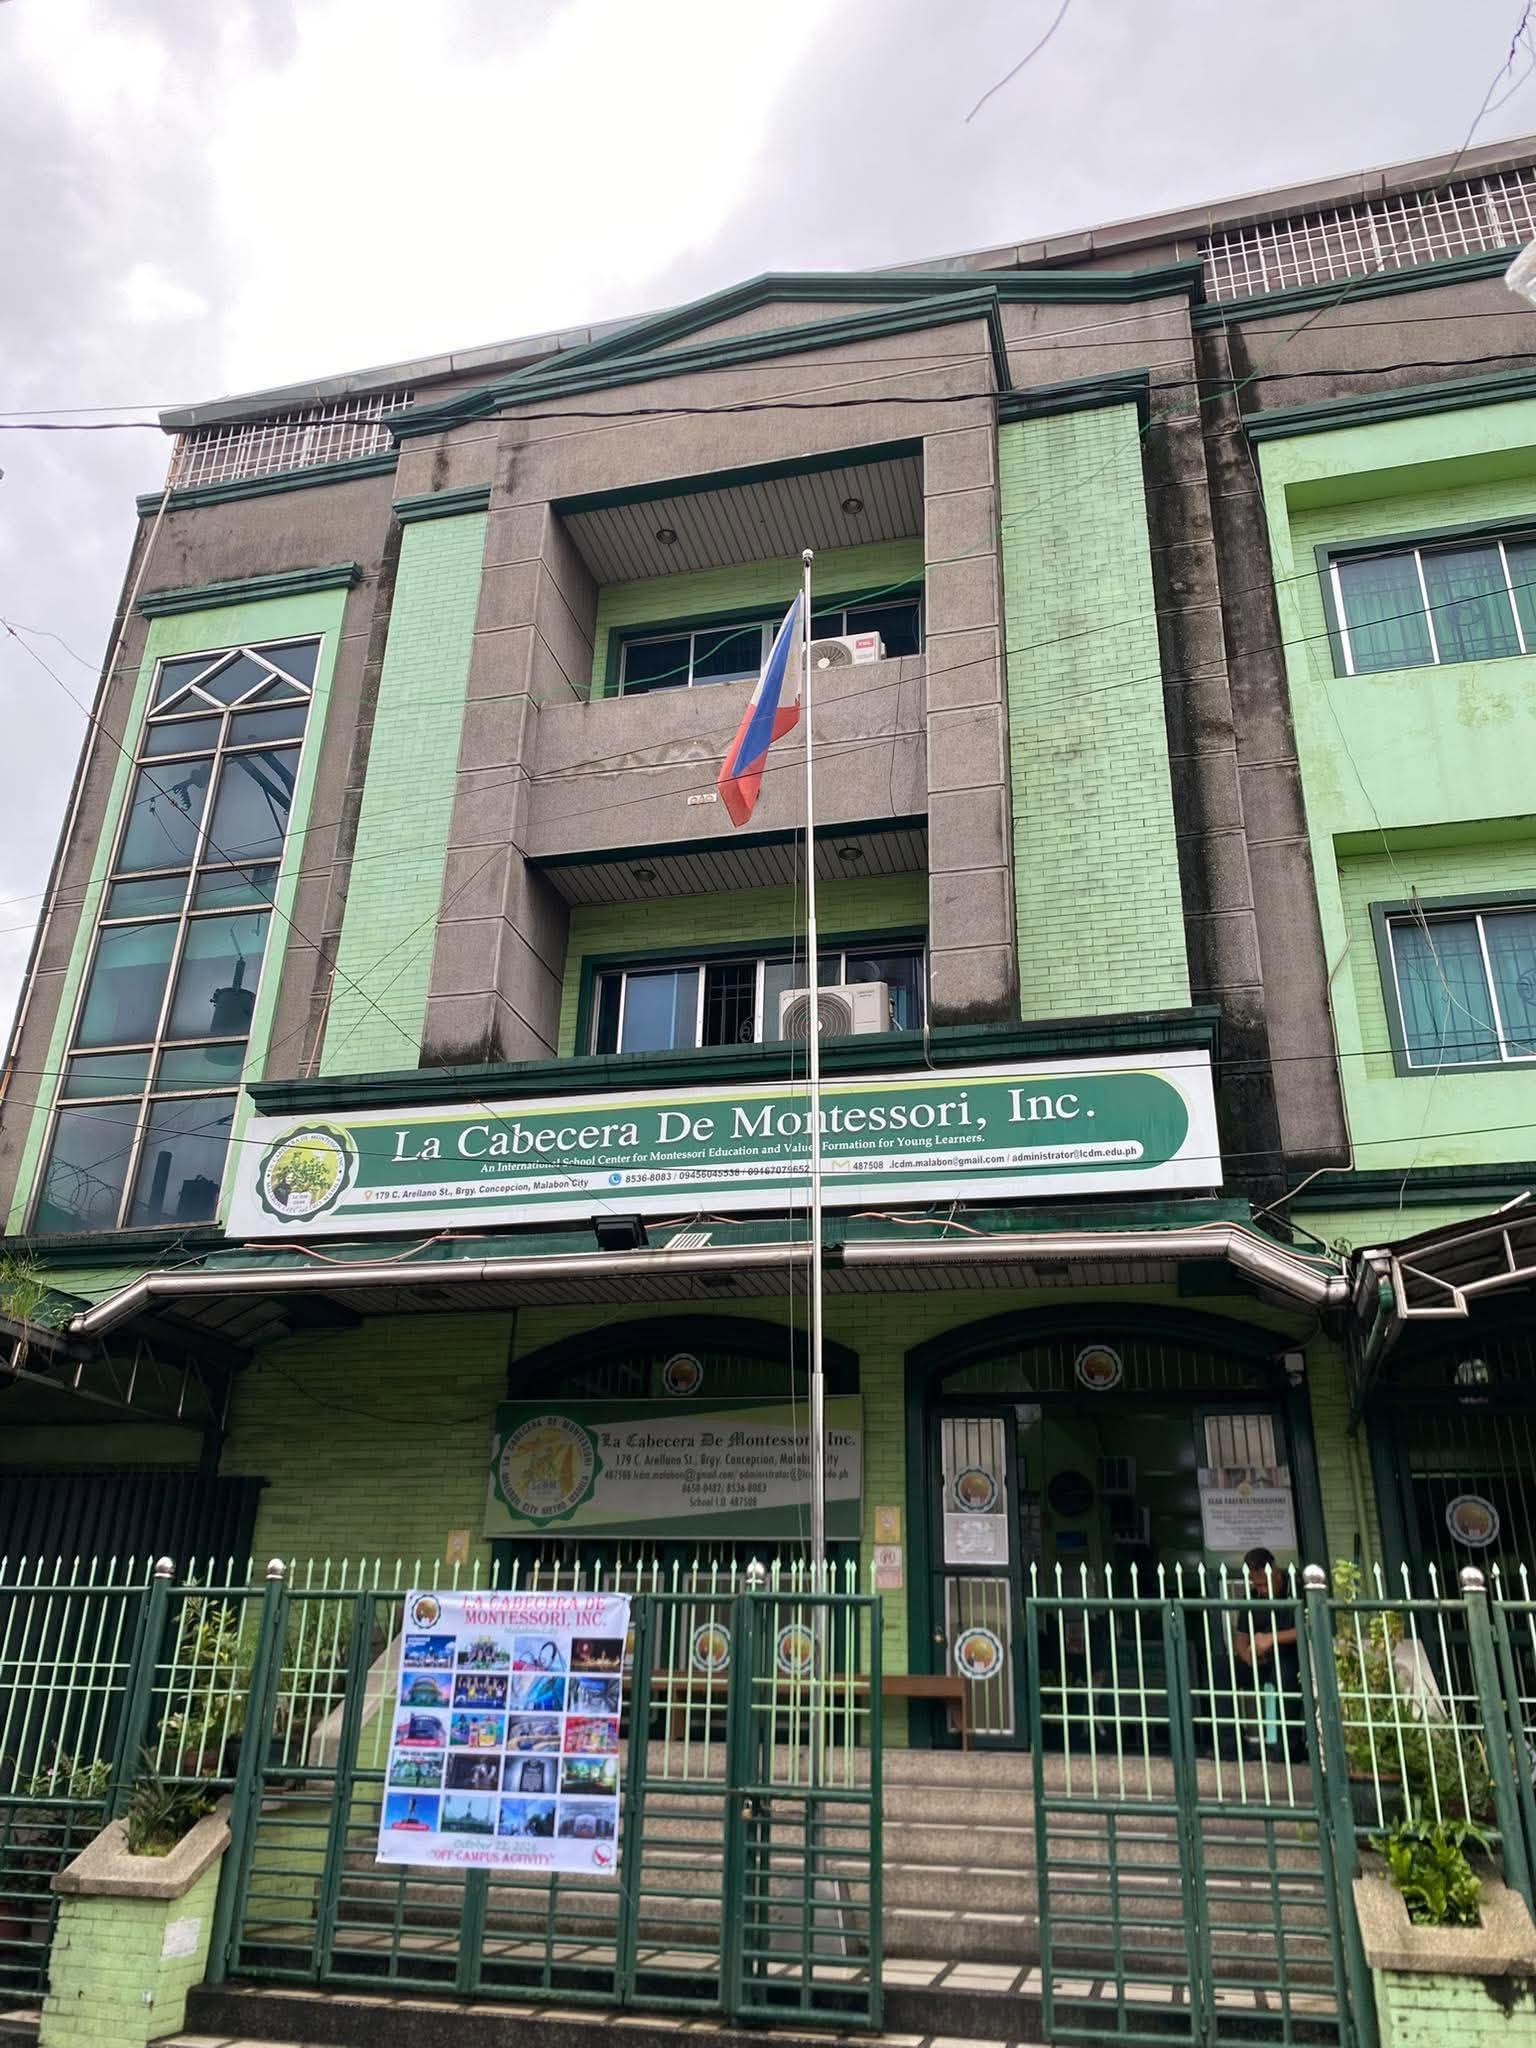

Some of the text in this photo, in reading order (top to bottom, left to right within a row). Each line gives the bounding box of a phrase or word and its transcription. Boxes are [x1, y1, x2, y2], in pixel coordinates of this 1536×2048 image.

[391, 1087, 1095, 1162] La Cabecera De Montessori, Inc.
[480, 1162, 495, 1173] An
[498, 1158, 560, 1172] International
[563, 1155, 597, 1167] School
[598, 1154, 631, 1166] Center
[632, 1153, 648, 1163] for
[650, 1148, 706, 1161] Montessori
[709, 1145, 760, 1158] Education
[761, 1143, 781, 1154] and
[821, 1137, 877, 1151] Formation
[878, 1136, 895, 1148] for
[897, 1135, 933, 1149] Young
[934, 1132, 986, 1146] Learners.
[852, 1160, 885, 1171] 487508
[625, 1172, 673, 1184] 8536-8083
[374, 1191, 391, 1201] 179
[392, 1190, 401, 1200] C.
[438, 1187, 453, 1198] St.,
[455, 1186, 477, 1198] Brgy.
[478, 1183, 531, 1195] Concepcion,
[533, 1180, 570, 1191] Malabon
[571, 1178, 590, 1189] City
[600, 1431, 857, 1449] La Cabecera De Montessor Inc.
[616, 1453, 632, 1466] 179
[779, 1452, 811, 1466] Malab
[463, 1595, 607, 1611] LA CABECERA DE
[464, 1610, 608, 1628] MONTESSORI, INC.
